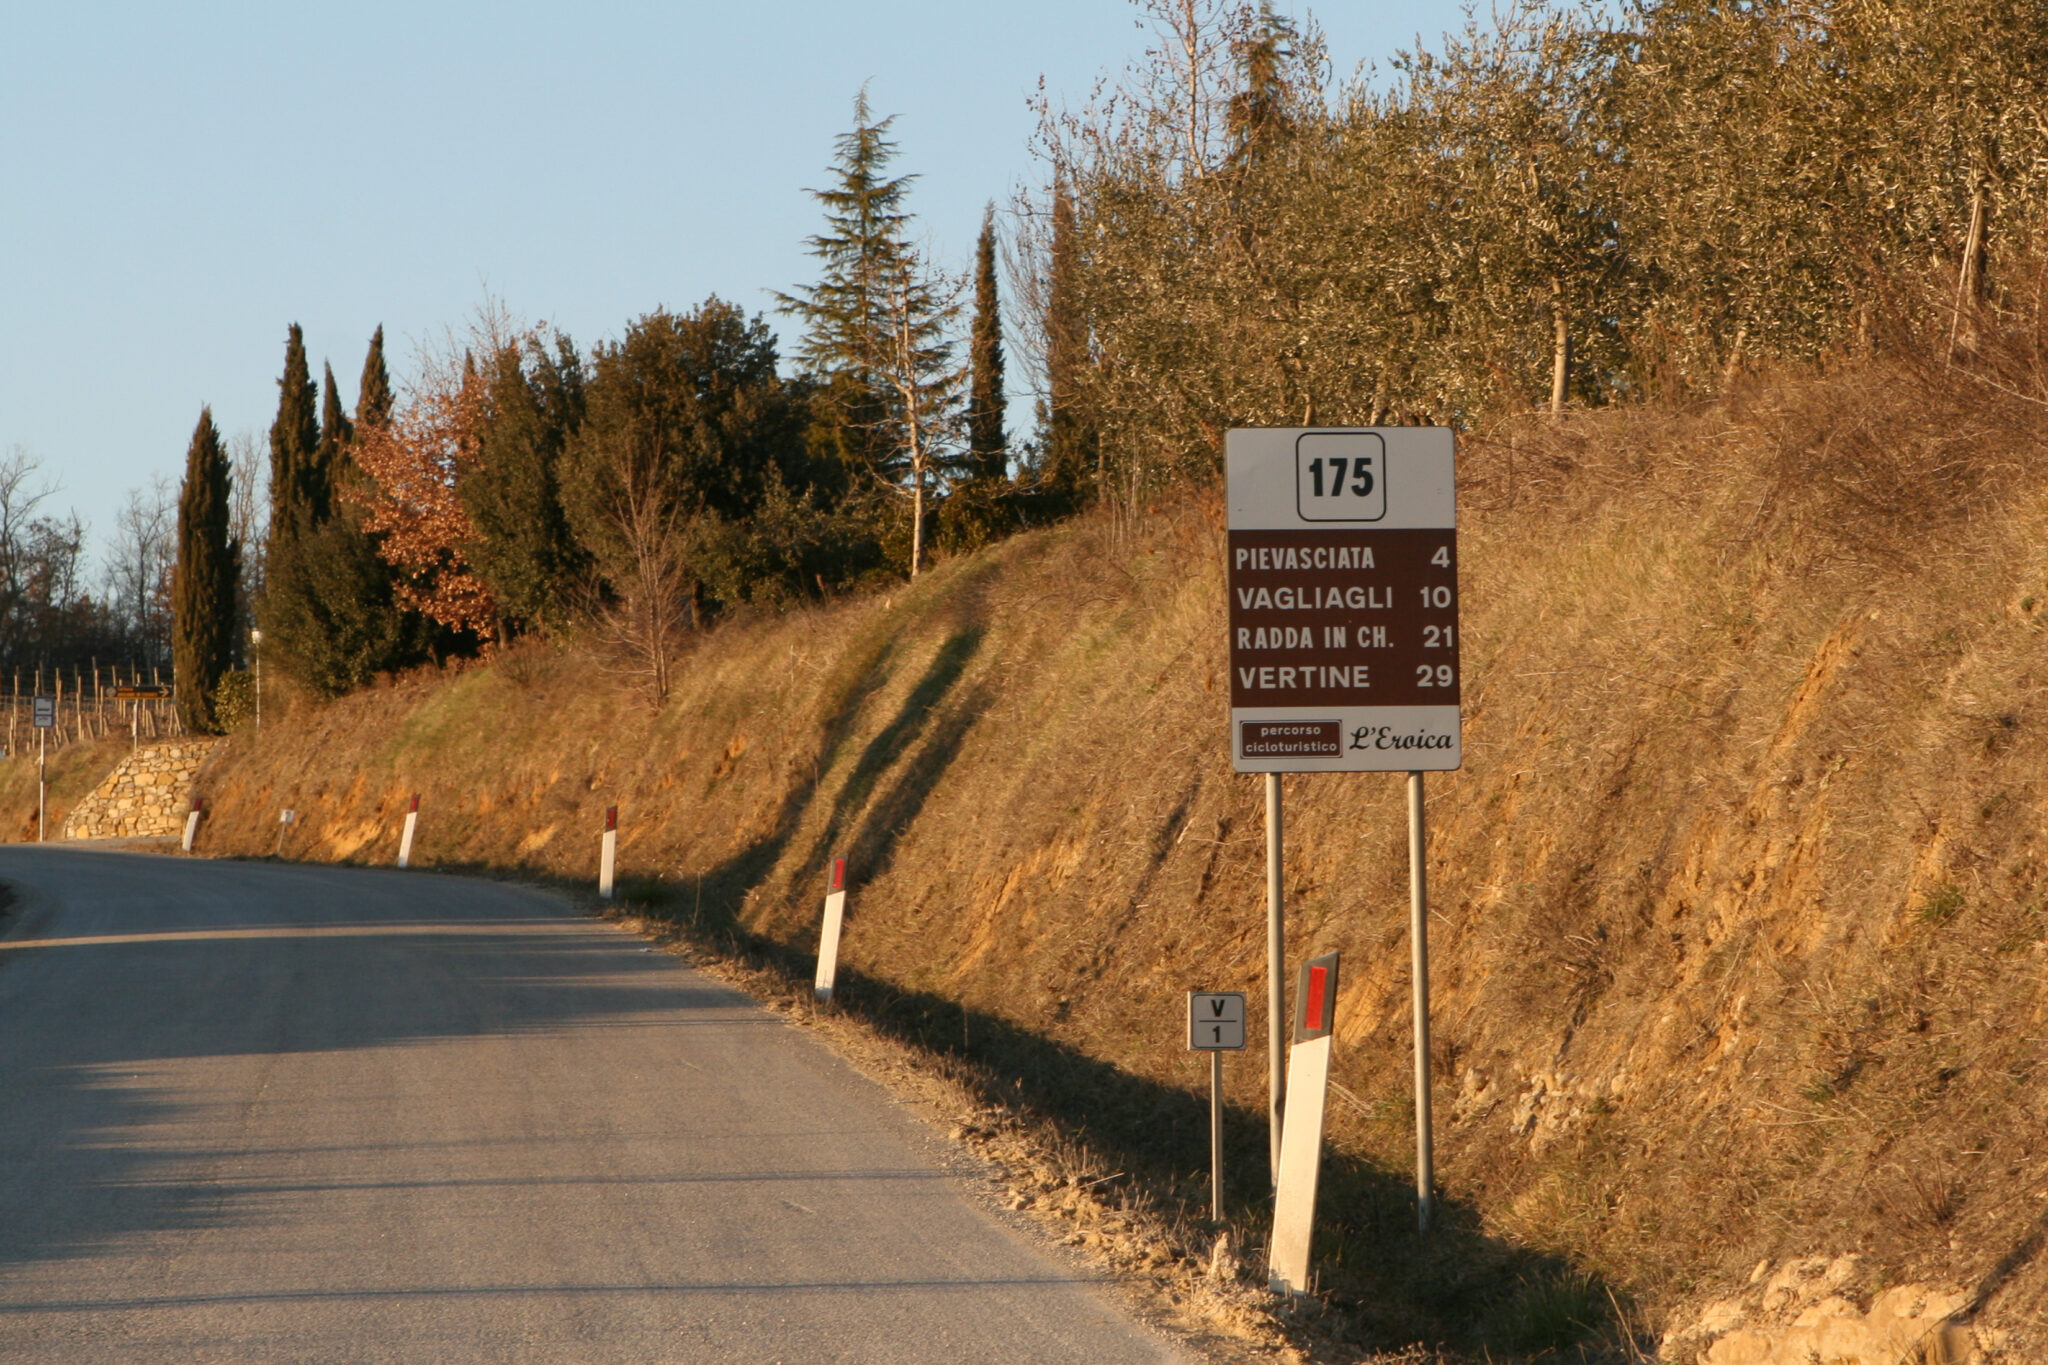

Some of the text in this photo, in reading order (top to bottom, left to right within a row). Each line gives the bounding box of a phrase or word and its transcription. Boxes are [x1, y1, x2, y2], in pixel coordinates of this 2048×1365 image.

[1309, 457, 1374, 497] 175
[1235, 546, 1450, 570] PIEVASCIATA 4
[1237, 585, 1452, 610] VAGLIAGLI 10
[1237, 625, 1453, 650] RADDA IN CH. 21
[1239, 665, 1453, 689] VERTINE 29
[1260, 725, 1321, 738] percorso
[1349, 726, 1454, 751] L'Eroica
[1245, 740, 1338, 753] cicloturistico
[1211, 1000, 1225, 1017] V
[1212, 1026, 1220, 1043] 1
